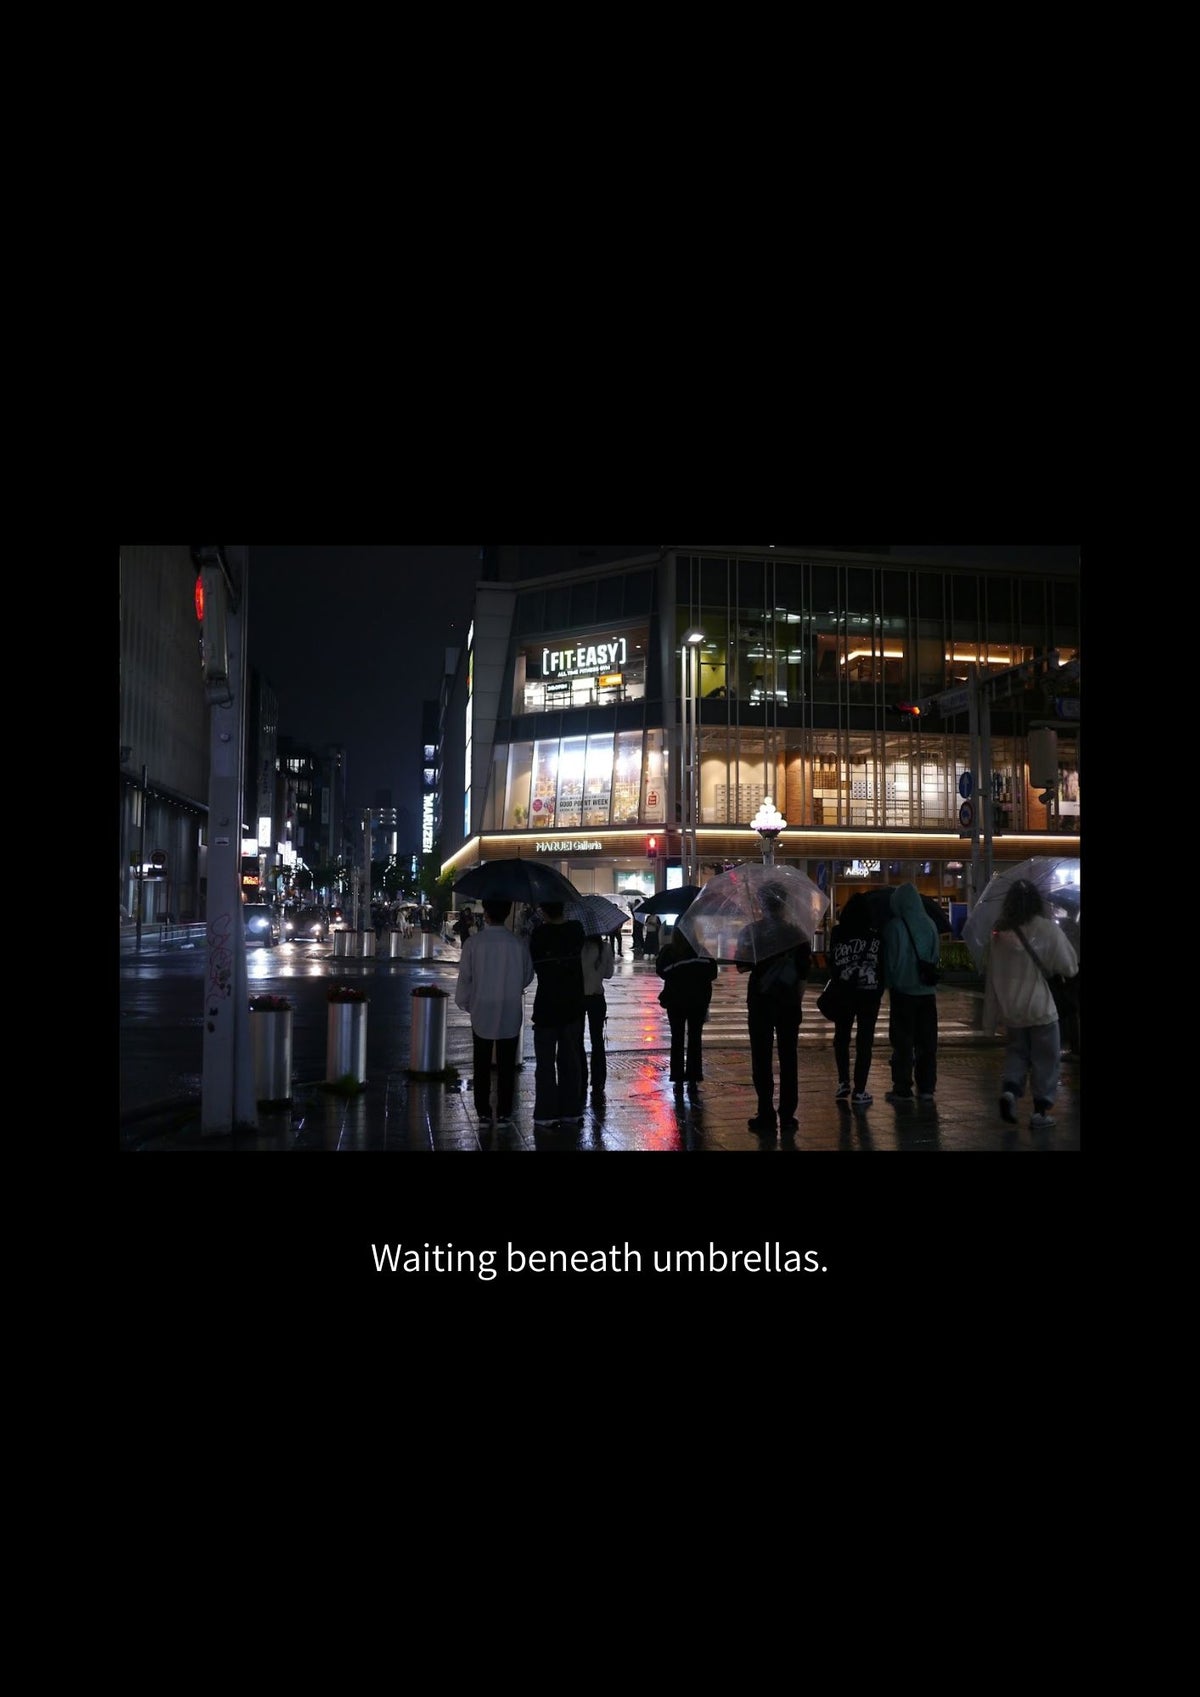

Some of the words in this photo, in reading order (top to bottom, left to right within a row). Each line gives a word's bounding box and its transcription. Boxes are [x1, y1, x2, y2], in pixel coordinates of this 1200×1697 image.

[573, 799, 591, 807] PONT
[592, 798, 609, 806] WEEK
[422, 792, 435, 854] MARUZEN
